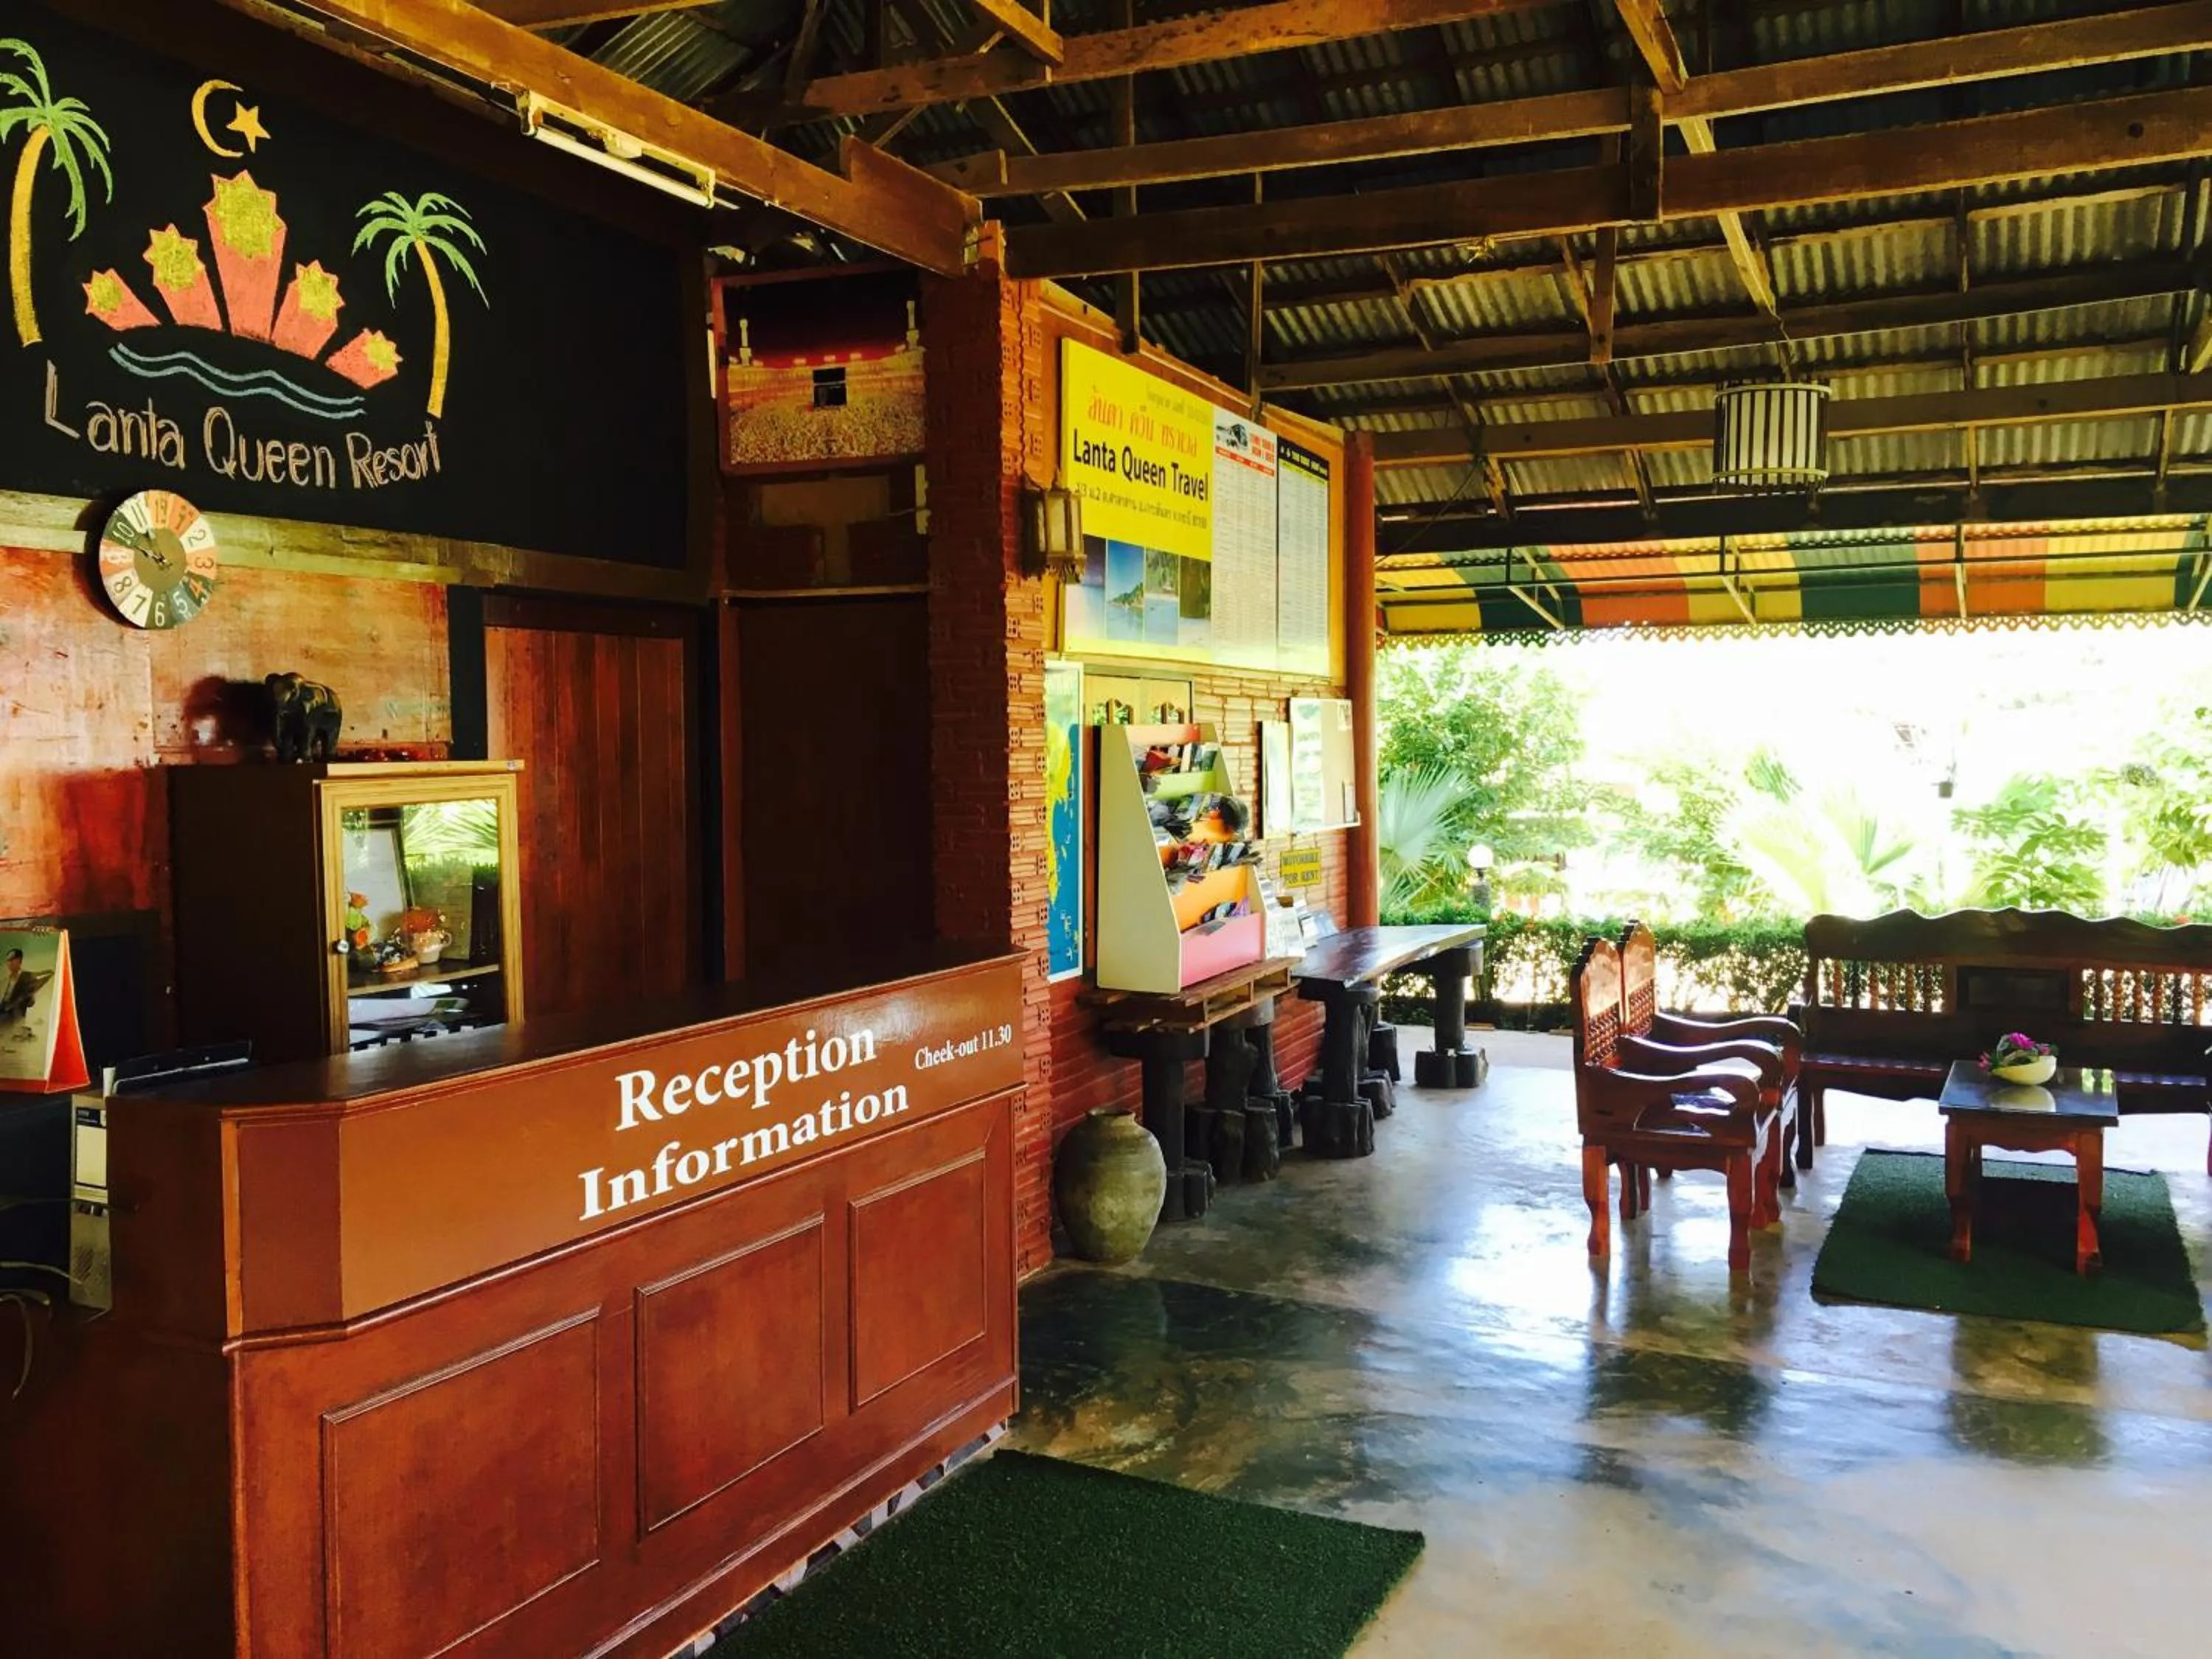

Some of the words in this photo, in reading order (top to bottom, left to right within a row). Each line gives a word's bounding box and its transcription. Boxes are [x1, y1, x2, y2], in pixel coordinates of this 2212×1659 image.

[44, 358, 187, 470] Lanta
[203, 406, 336, 489] Queen
[346, 420, 442, 489] Resort
[1073, 428, 1116, 473] Lanta
[1121, 445, 1166, 488] Queen
[1171, 462, 1208, 501] Travel
[113, 522, 135, 544] 10
[189, 529, 206, 547] 2
[195, 557, 215, 570] 3
[114, 576, 132, 593] 8
[132, 594, 147, 615] 7
[155, 602, 165, 627] 6
[173, 591, 189, 614] 5
[981, 1024, 1012, 1050] 11.30
[614, 1029, 877, 1132] Reception
[579, 1085, 909, 1221] Information
